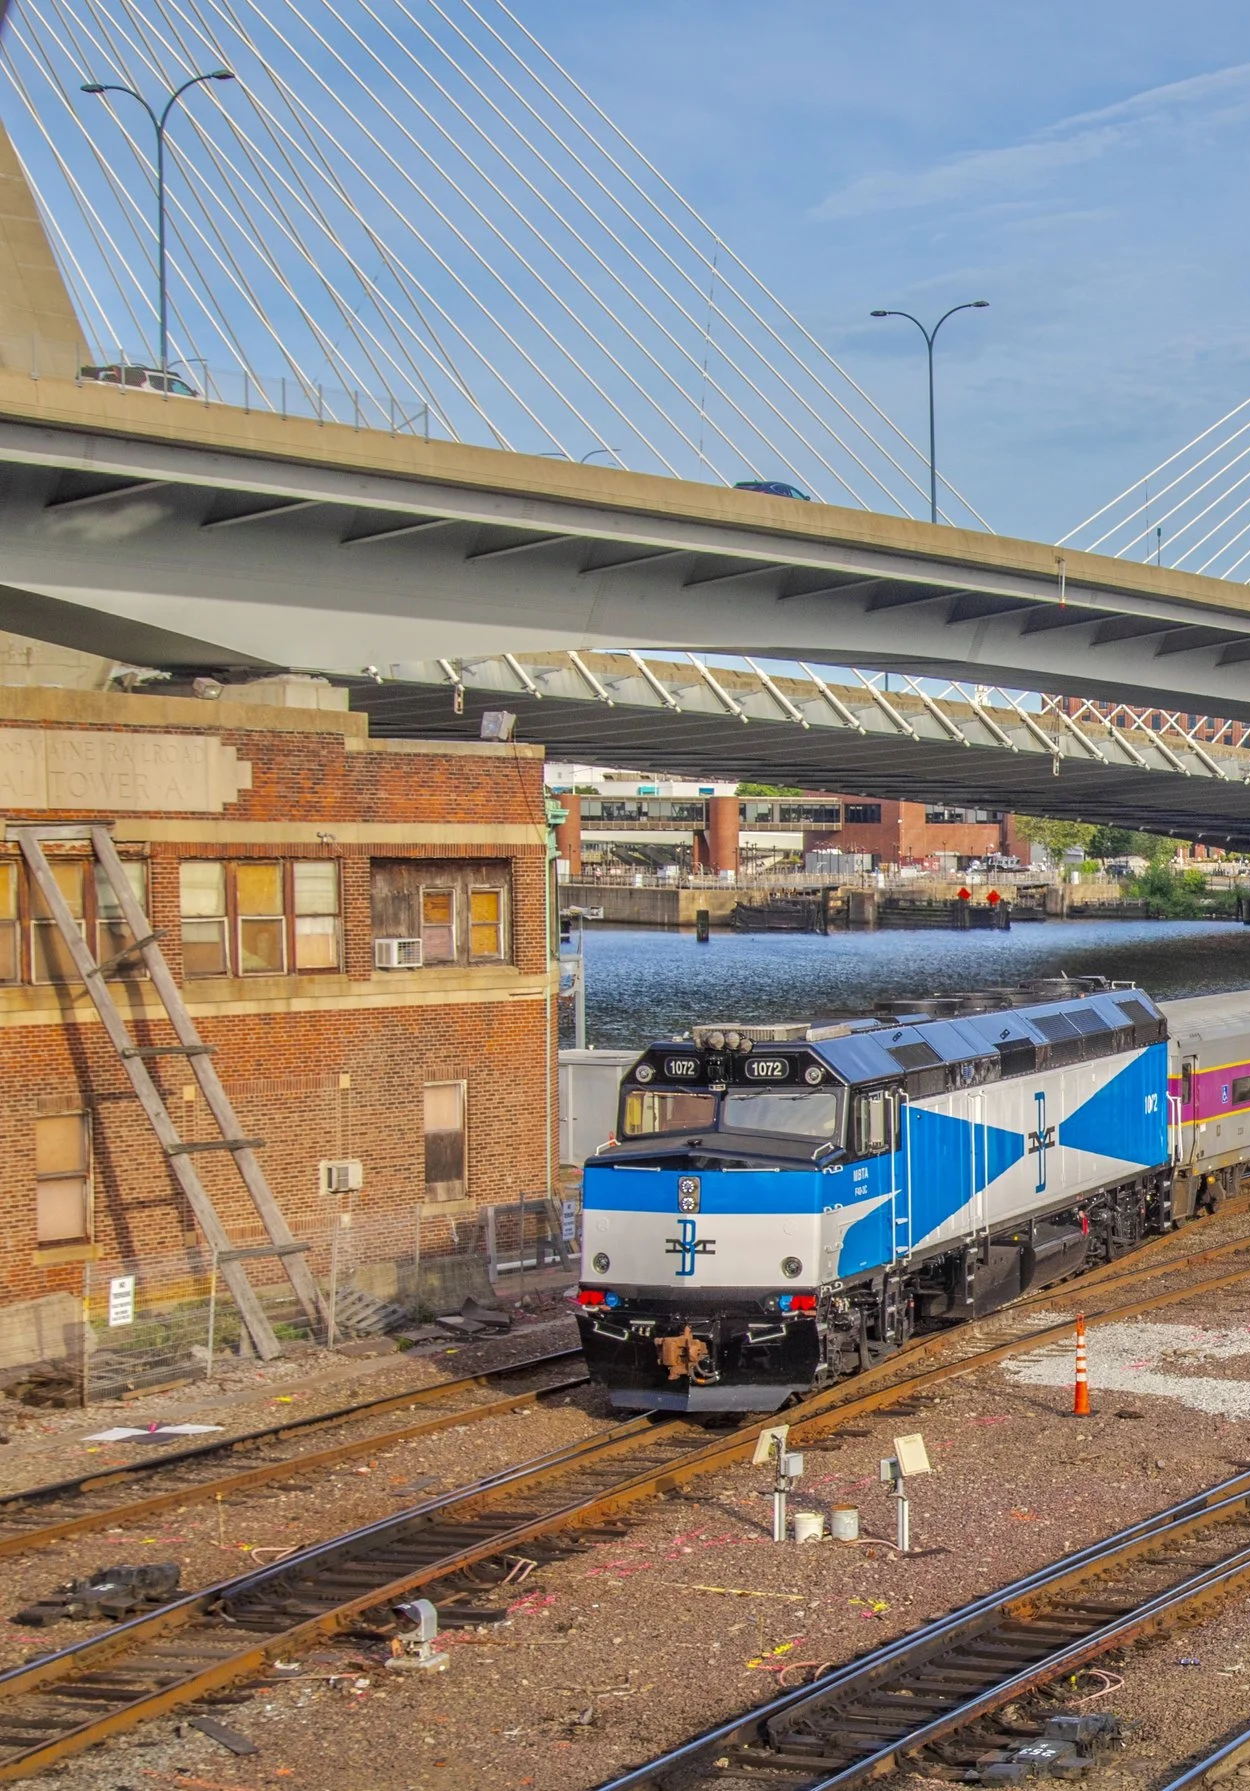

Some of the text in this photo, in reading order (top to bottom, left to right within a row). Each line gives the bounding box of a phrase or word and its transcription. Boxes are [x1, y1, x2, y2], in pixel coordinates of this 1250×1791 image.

[50, 770, 150, 800] TOWER
[670, 1060, 695, 1075] 1072
[752, 1062, 782, 1076] 1072
[853, 1167, 869, 1182] MBTA
